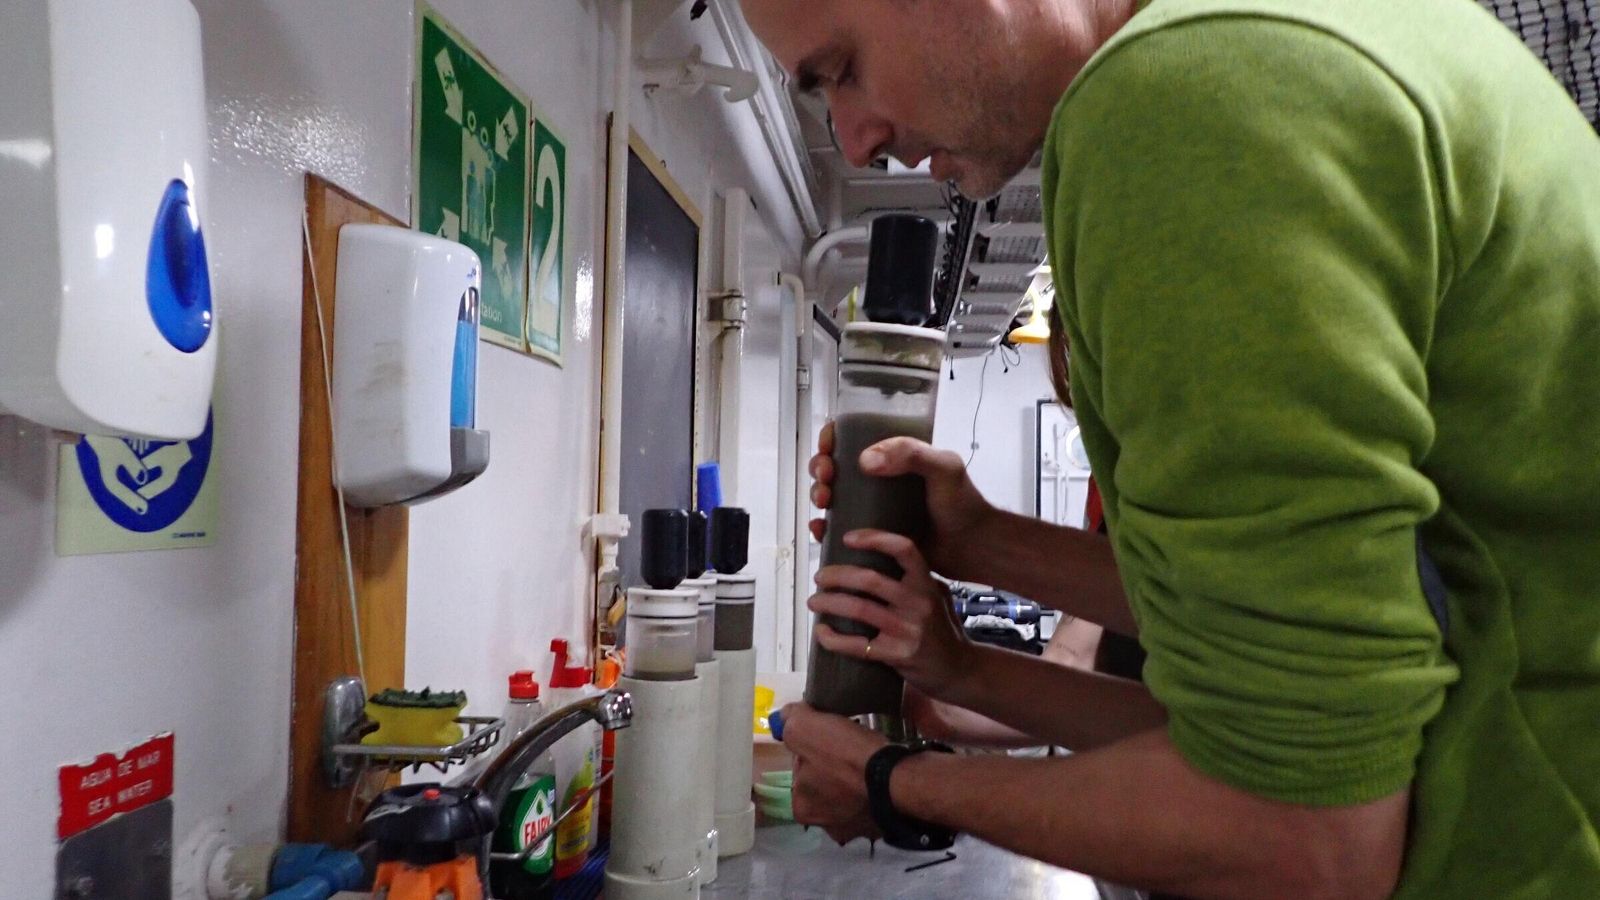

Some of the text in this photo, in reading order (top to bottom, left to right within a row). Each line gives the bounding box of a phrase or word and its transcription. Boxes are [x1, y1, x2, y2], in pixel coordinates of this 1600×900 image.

[532, 144, 560, 338] 2
[480, 302, 503, 323] tation
[81, 767, 111, 788] AGUA
[117, 759, 132, 776] DE
[88, 779, 152, 815] SEA WATER
